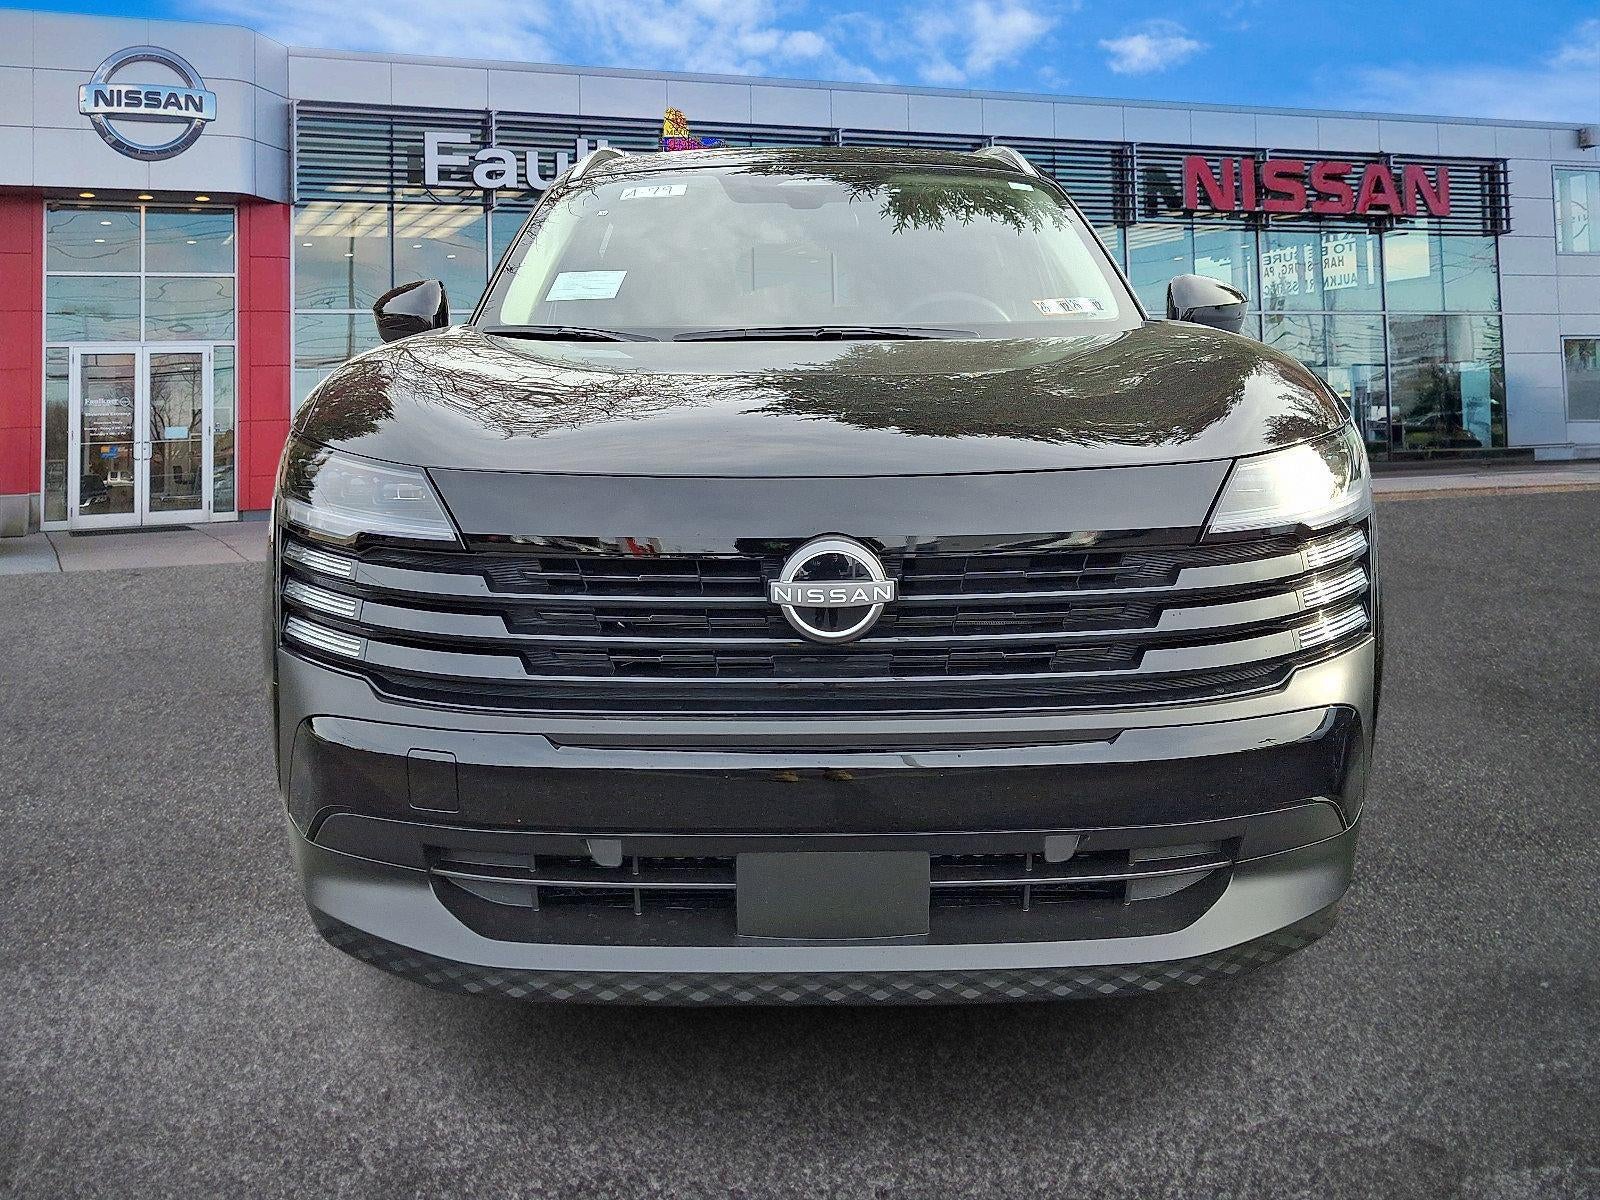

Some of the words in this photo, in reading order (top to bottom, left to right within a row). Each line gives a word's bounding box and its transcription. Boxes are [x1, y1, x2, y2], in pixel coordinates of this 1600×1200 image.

[93, 89, 204, 113] NISSAN
[423, 131, 609, 191] Fau
[1183, 155, 1451, 216] NISSAN
[774, 585, 891, 603] NISSAN
